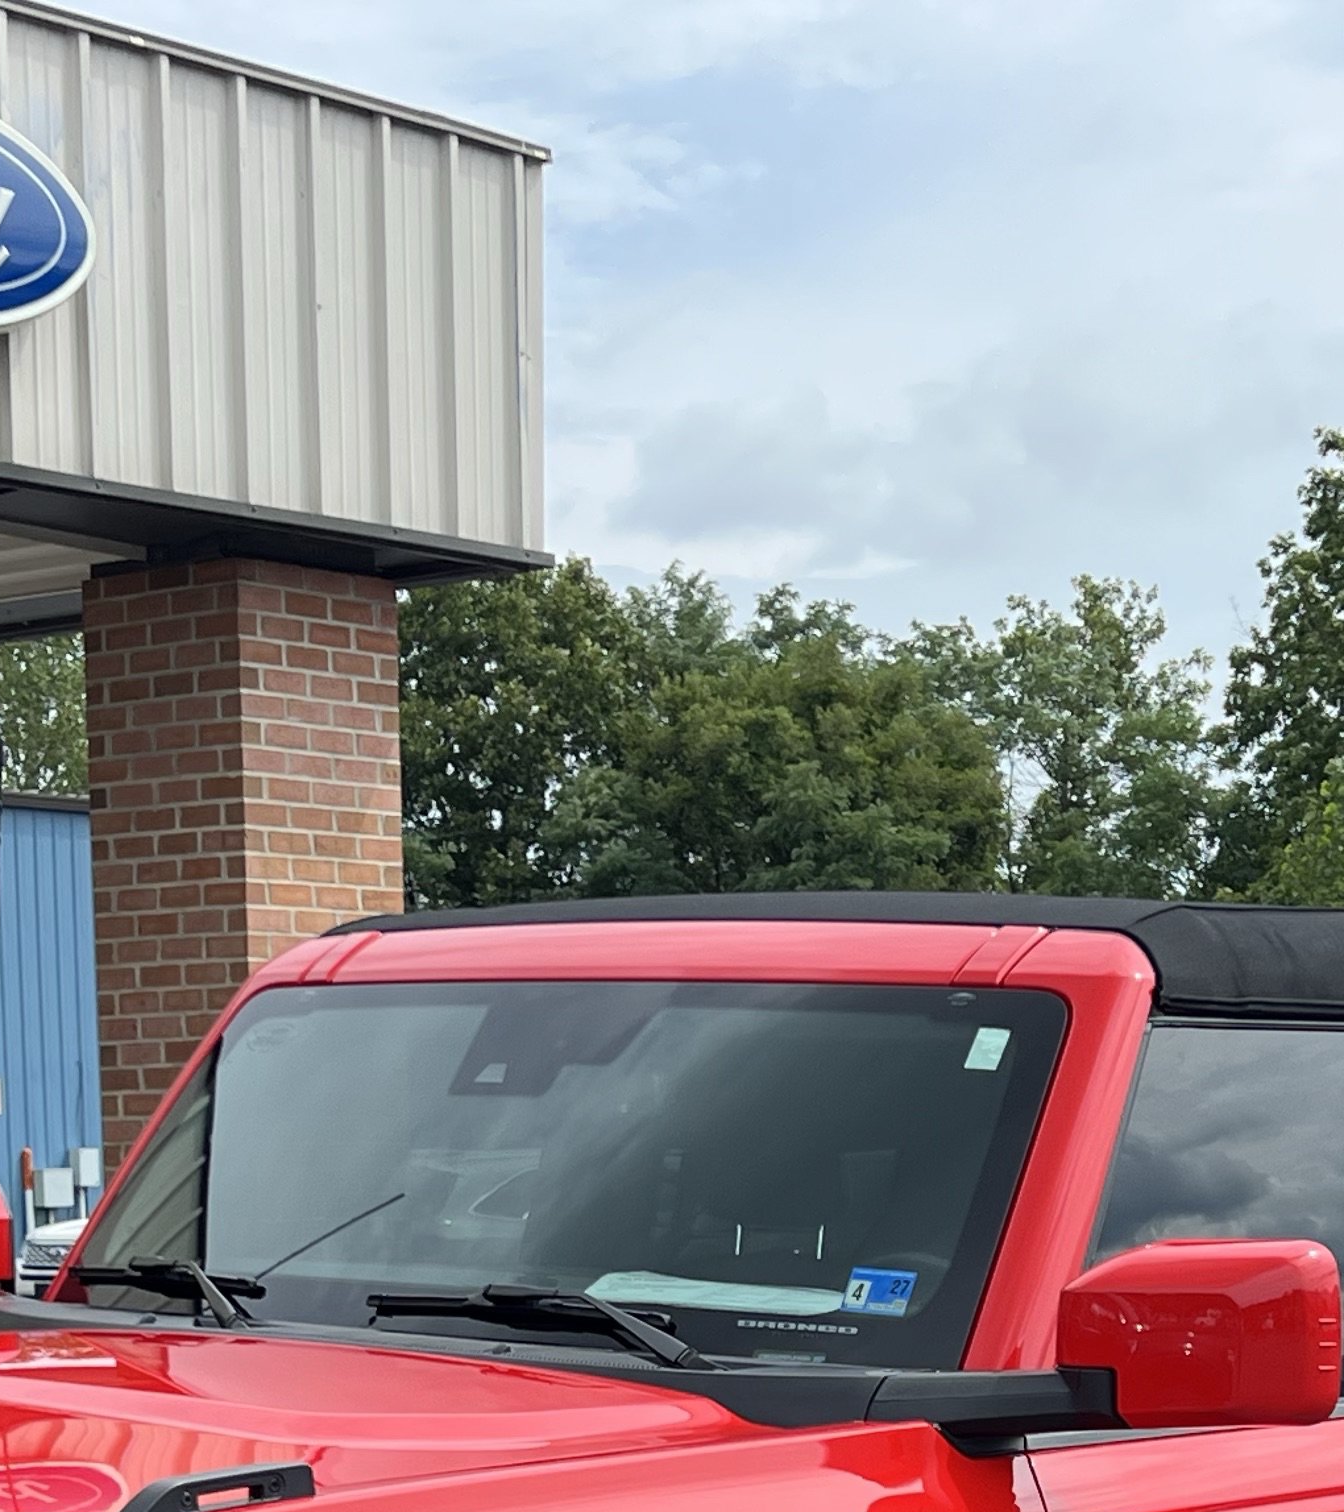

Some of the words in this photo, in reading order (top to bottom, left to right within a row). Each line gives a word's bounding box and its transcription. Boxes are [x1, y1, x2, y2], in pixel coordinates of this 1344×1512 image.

[851, 1283, 865, 1301] 4
[888, 1279, 911, 1297] 27
[737, 1319, 859, 1335] BRONCO
